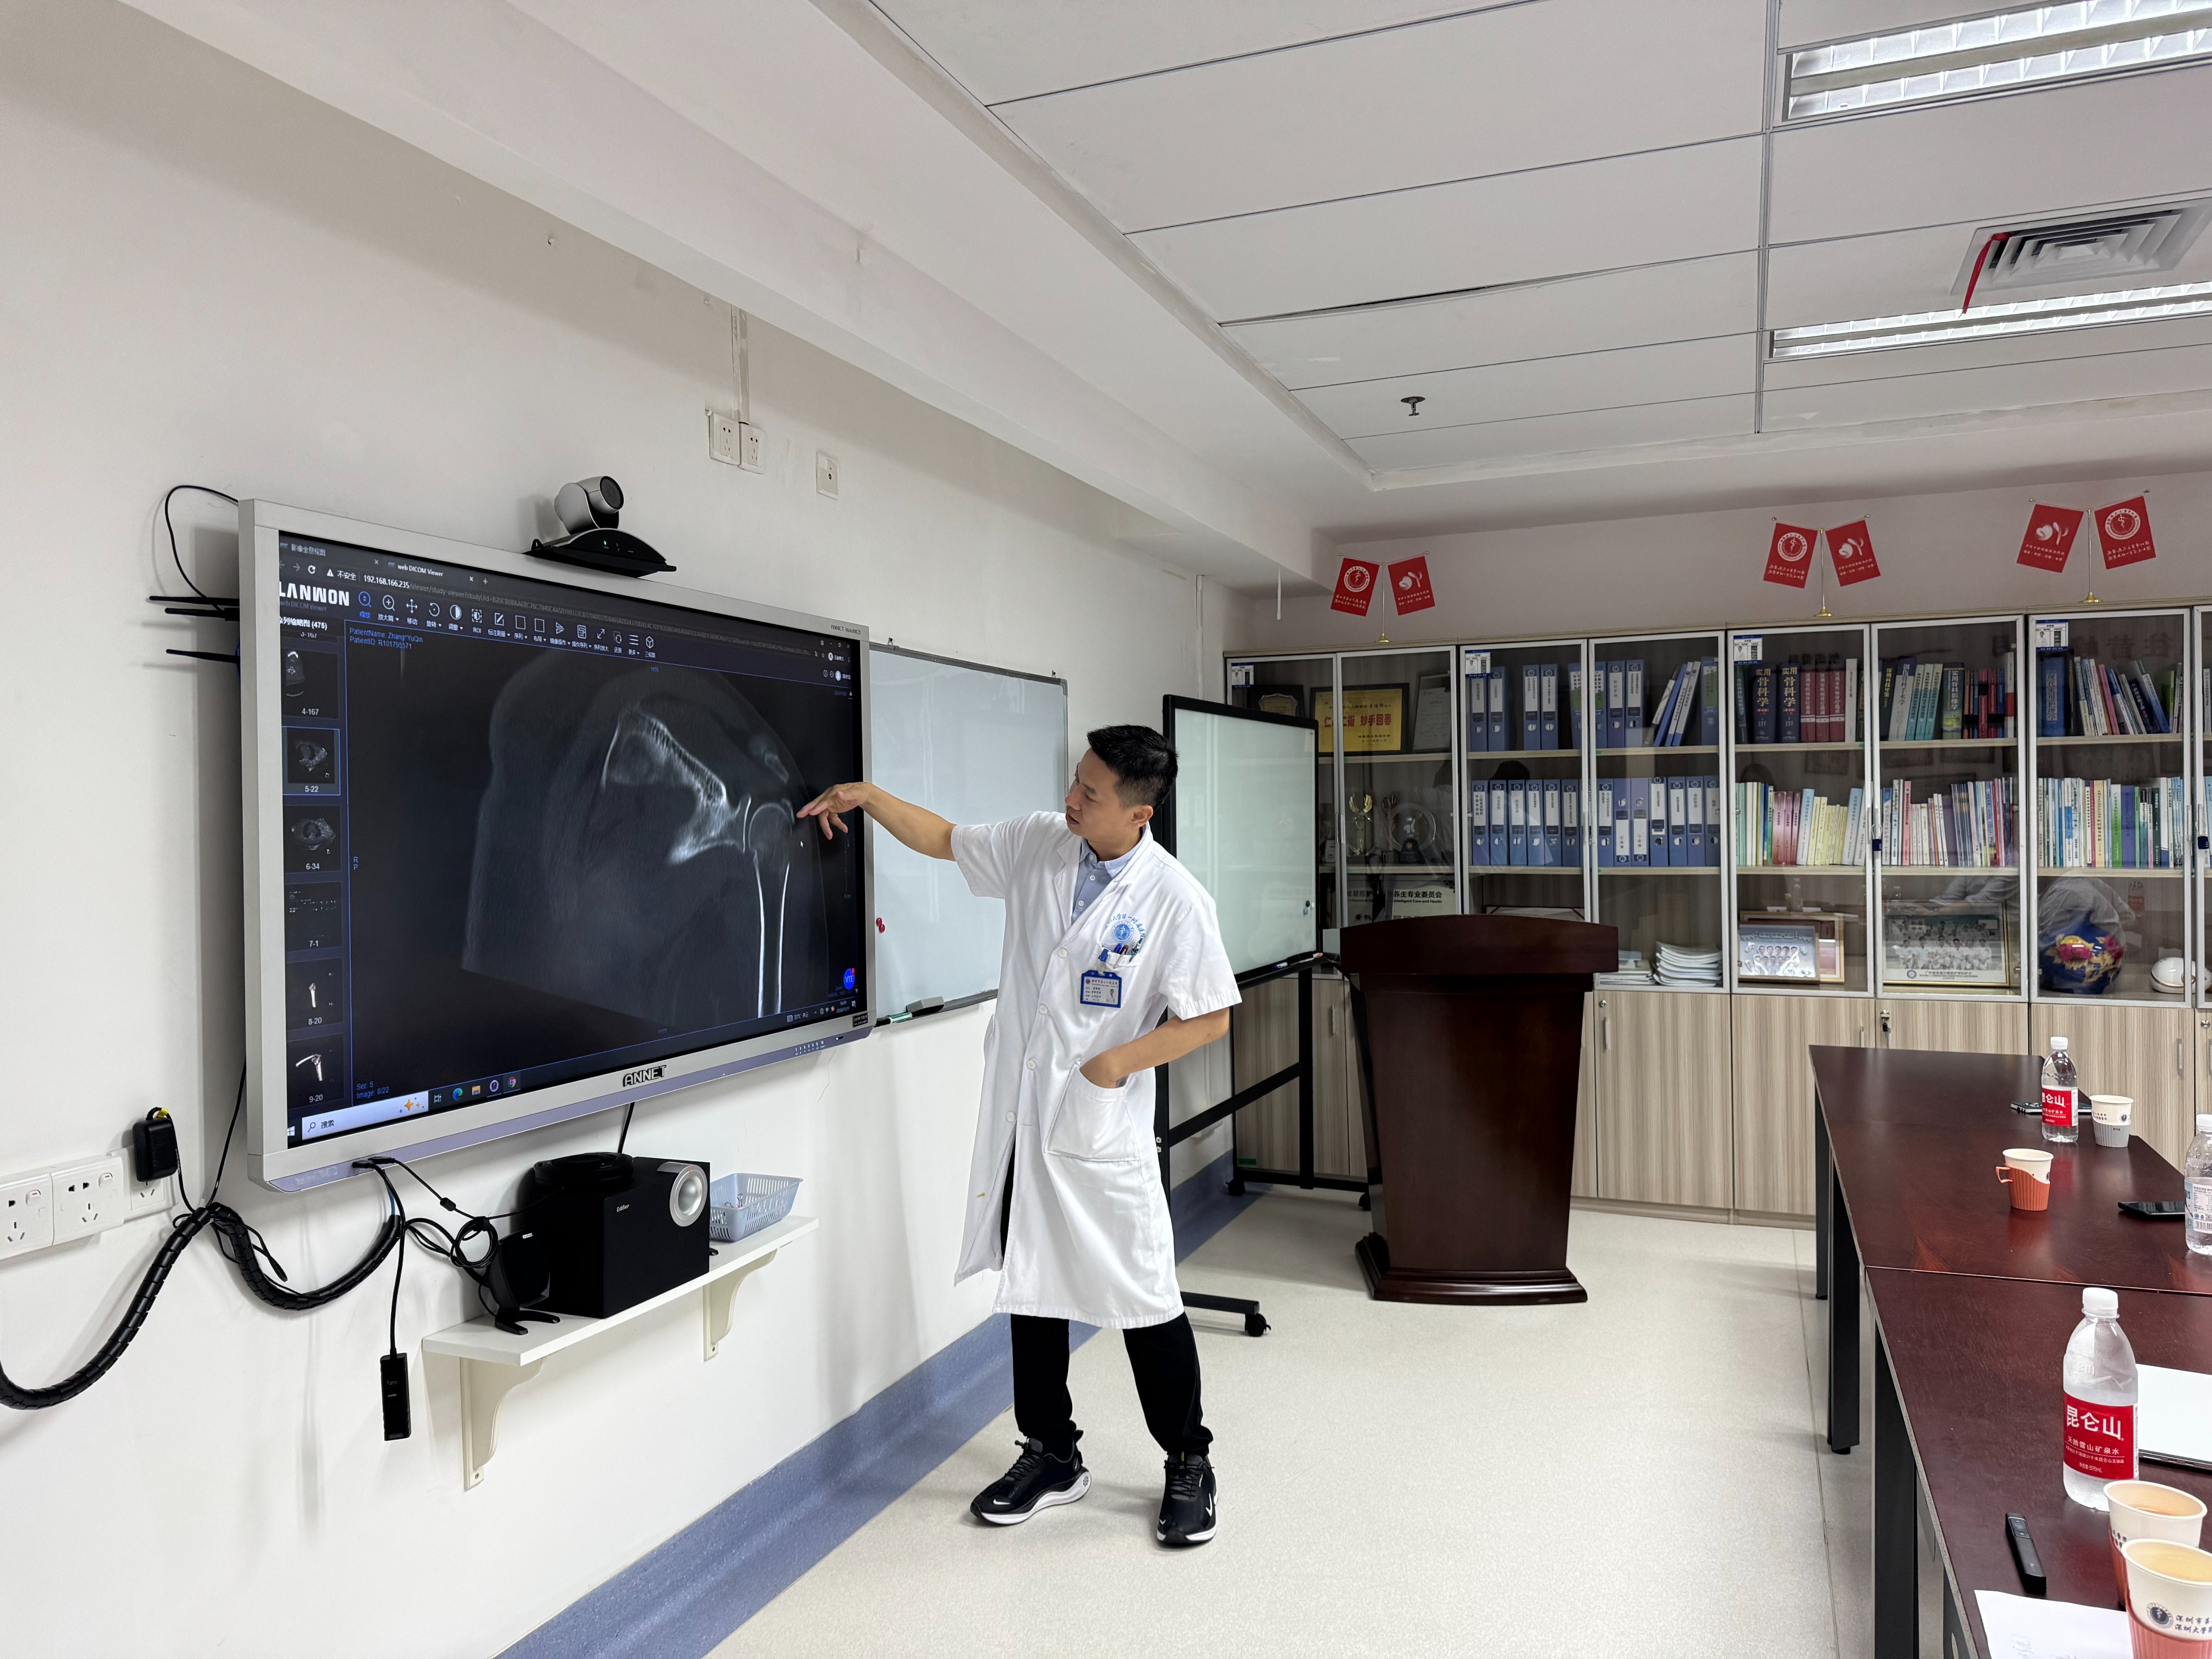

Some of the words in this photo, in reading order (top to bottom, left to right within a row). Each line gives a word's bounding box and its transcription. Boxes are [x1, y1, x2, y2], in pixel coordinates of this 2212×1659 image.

[337, 570, 356, 580] 不安全
[409, 565, 426, 574] DICOM
[279, 581, 349, 607] LANWON
[378, 614, 394, 622] 放大镜
[311, 621, 327, 631] (475)
[488, 629, 505, 637] 标注测量
[1757, 677, 1770, 707] 骨科学
[1784, 677, 1797, 707] 骨科学
[1324, 715, 1355, 728] 仁術
[1360, 714, 1392, 726] 妙手回春
[623, 1065, 667, 1087] ANNET
[309, 1094, 323, 1103] 9-20
[321, 1119, 335, 1129] 搜索
[2067, 1404, 2121, 1440] 昆仑山
[2068, 1436, 2119, 1455] 天然雪山矿泉水
